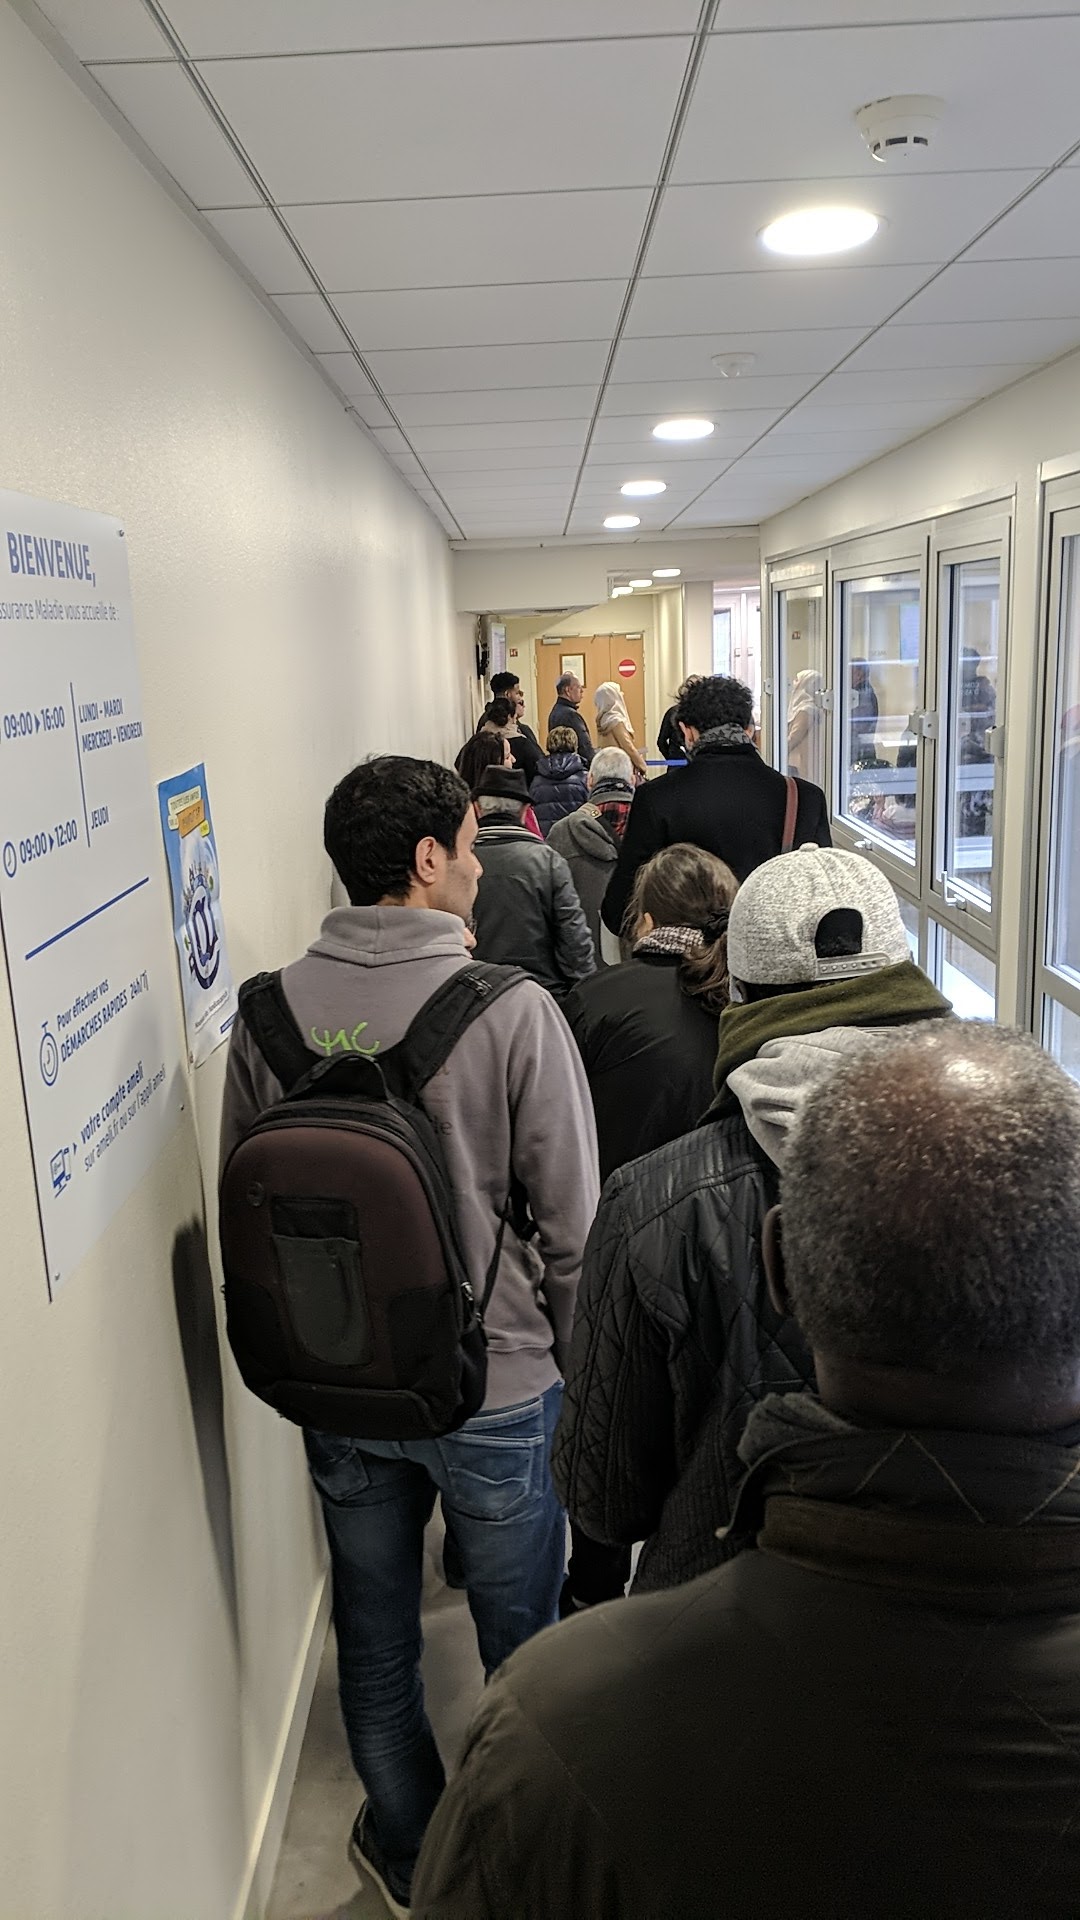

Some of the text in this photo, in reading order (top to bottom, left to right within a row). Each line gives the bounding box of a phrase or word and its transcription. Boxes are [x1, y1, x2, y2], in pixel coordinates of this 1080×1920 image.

[7, 531, 96, 588] BIENVENUE,
[35, 599, 64, 620] Maladie
[65, 604, 81, 620] vous
[81, 600, 108, 621] accueille
[4, 705, 66, 739] 09:00 16:00
[78, 702, 99, 723] LUNDI
[103, 697, 123, 718] MARDI
[82, 728, 113, 752] MERCREDI
[116, 721, 143, 743] VENDREDI
[91, 805, 109, 830] JEUDI
[19, 819, 78, 864] 09:00 12:00
[57, 978, 109, 1032] Pour effectuer vos
[60, 1011, 103, 1063] DÉMARCHES
[102, 989, 128, 1025] RAPIDES
[81, 1060, 143, 1145] votre compte ameli
[84, 1148, 96, 1173] sur
[119, 1111, 128, 1130] ou
[127, 1100, 137, 1121] sur
[152, 1063, 166, 1091] ameli
